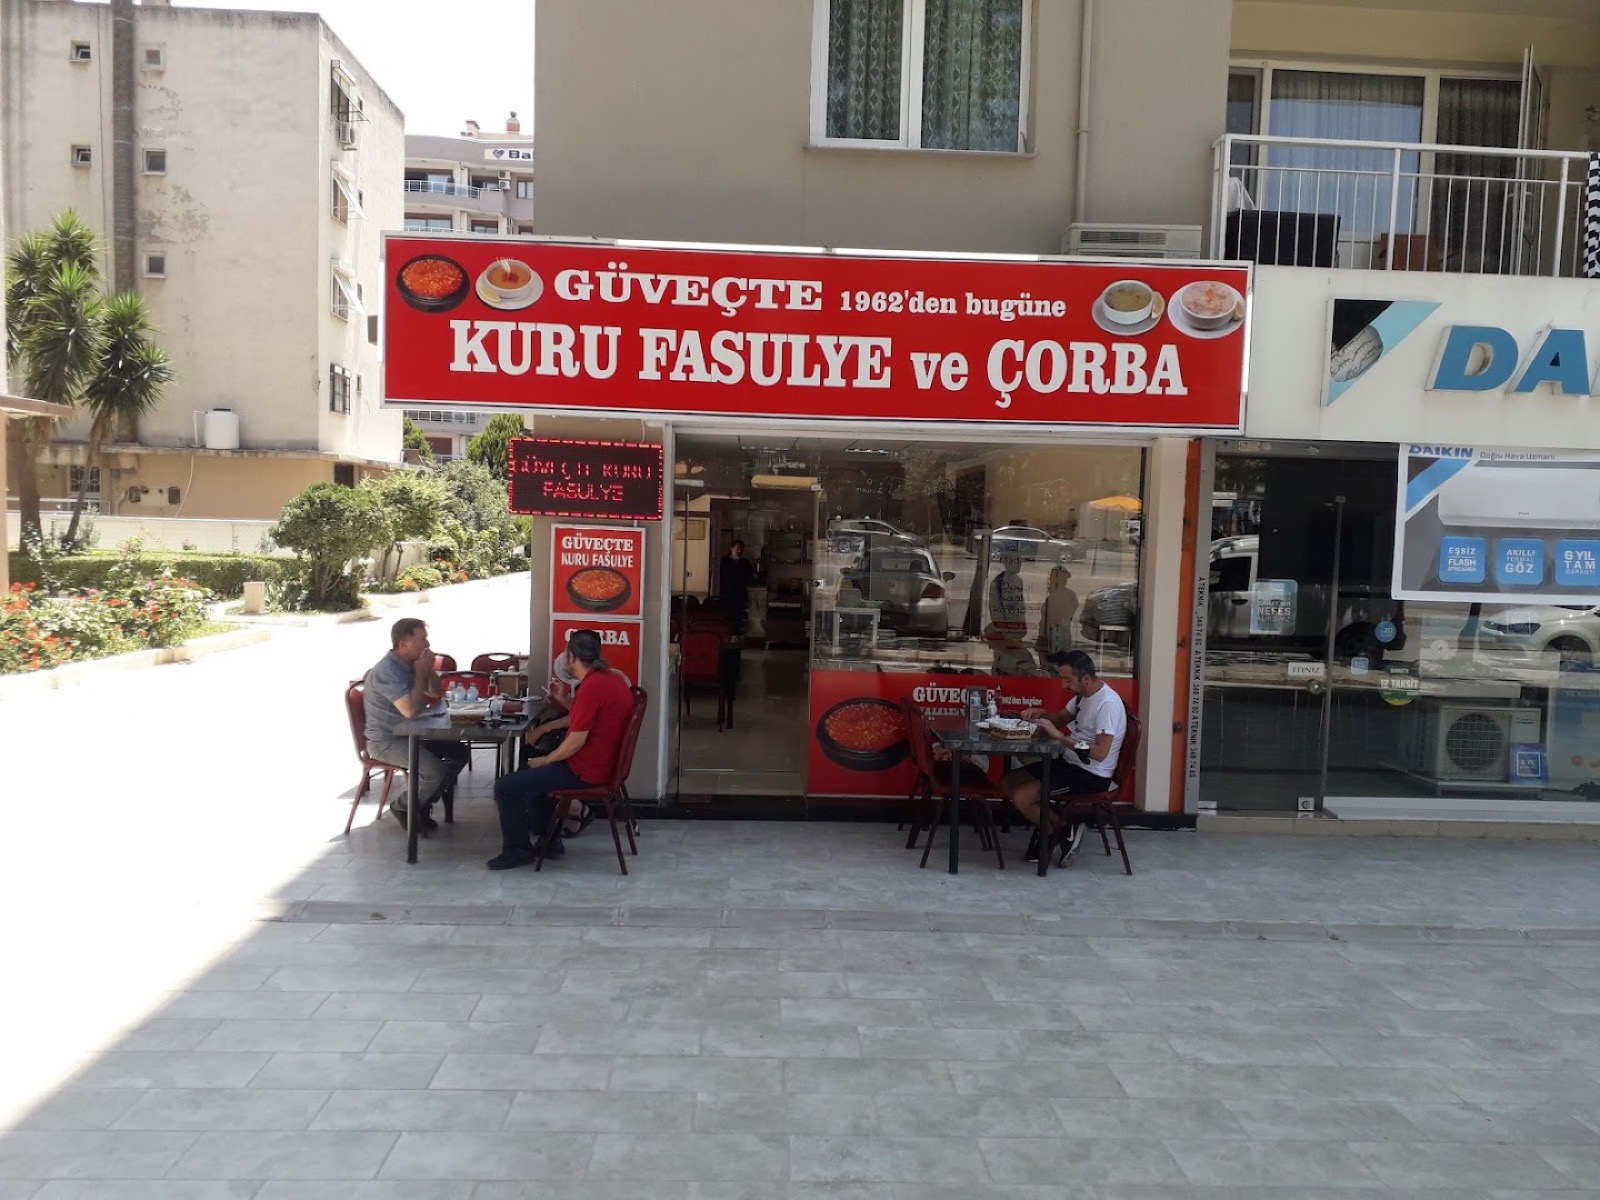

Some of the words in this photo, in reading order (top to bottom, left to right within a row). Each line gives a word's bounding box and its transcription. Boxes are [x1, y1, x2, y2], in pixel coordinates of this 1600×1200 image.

[554, 261, 823, 316] GÜVEÇTE
[840, 290, 958, 315] 1962'den
[965, 292, 1066, 321] bugüne
[449, 319, 622, 380] KURU
[638, 327, 892, 388] FASULYE
[910, 352, 969, 391] ve
[987, 338, 1188, 408] ÇORBA
[1430, 324, 1600, 397] DA
[1408, 445, 1473, 458] DAIKIN
[543, 481, 624, 501] FASULYE
[561, 532, 634, 555] GÜVEÇTE
[1448, 546, 1476, 556] EŞSİZ
[1506, 549, 1536, 557] AKILLI
[1575, 551, 1596, 561] YIL
[561, 552, 589, 566] KURU
[592, 554, 634, 568] FASULYE
[1448, 558, 1477, 567] FLASH
[1505, 561, 1535, 574] GÖZ
[1257, 607, 1292, 616] NEFES
[1391, 677, 1419, 690] TAKSİT
